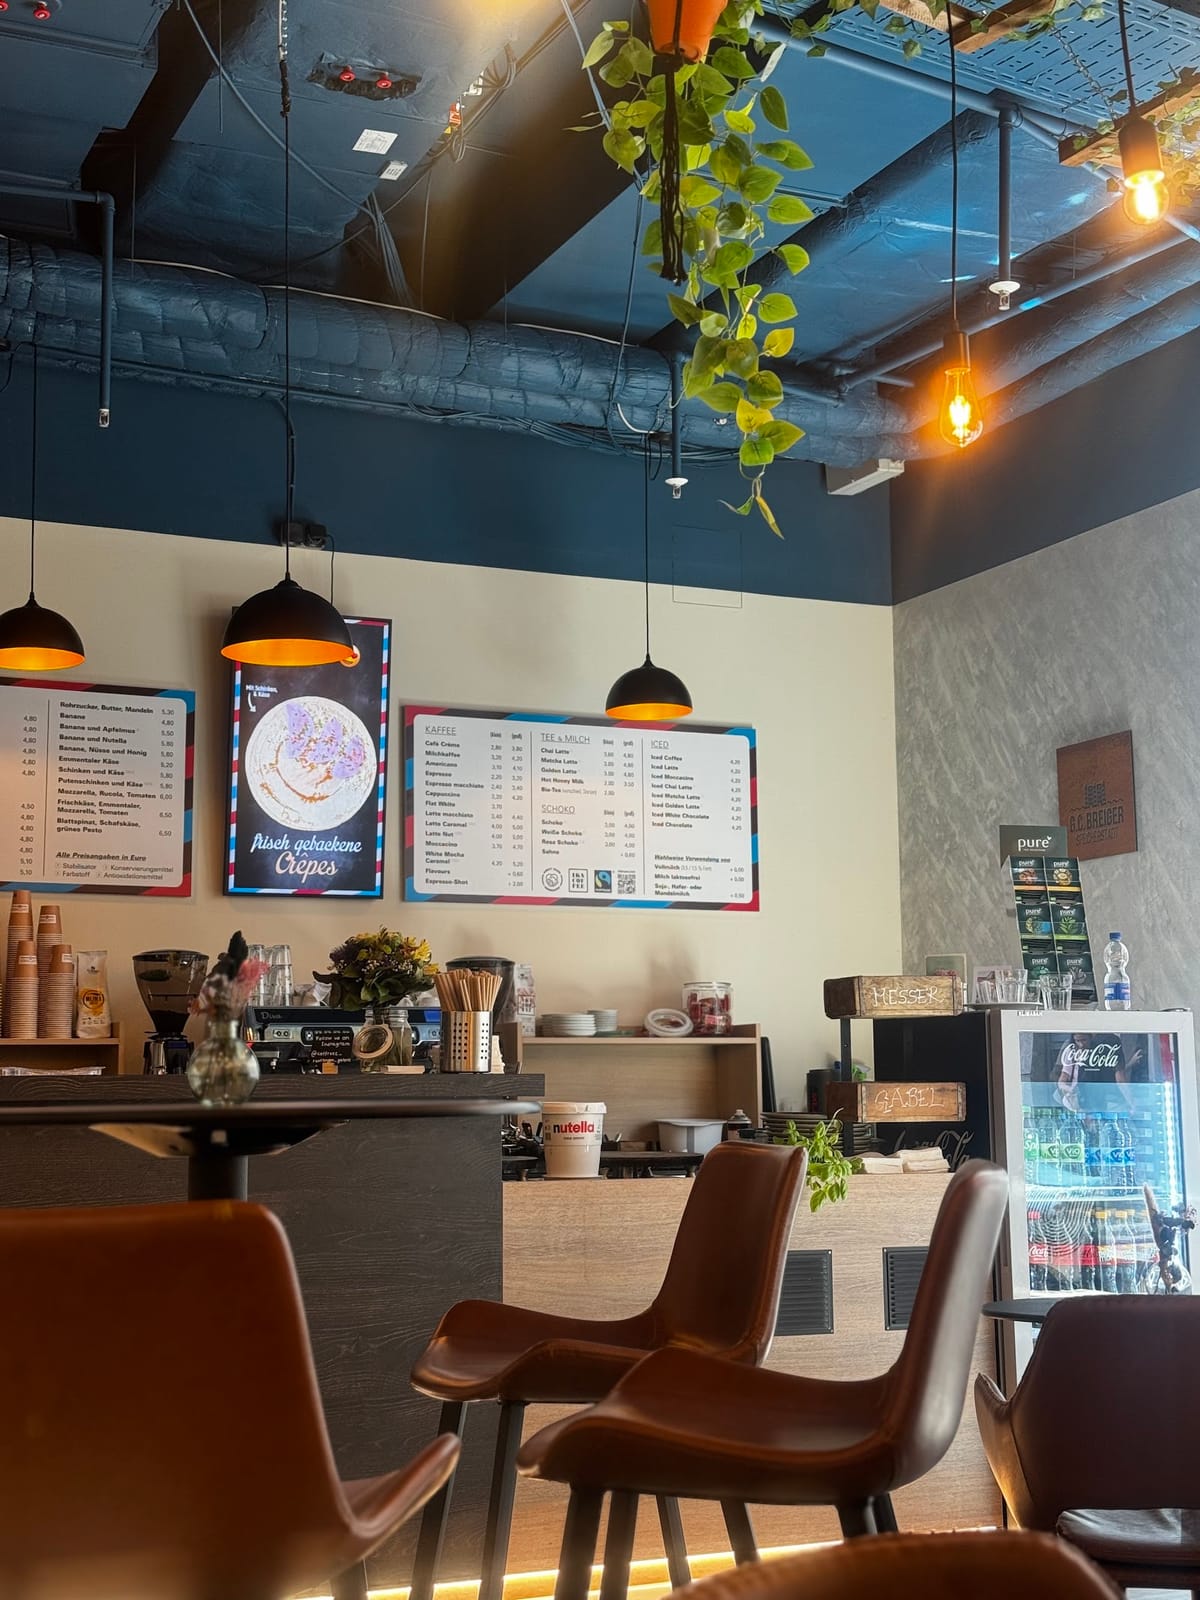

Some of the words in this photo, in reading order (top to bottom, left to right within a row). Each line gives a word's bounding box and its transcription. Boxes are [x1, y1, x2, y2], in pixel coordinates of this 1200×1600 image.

[60, 702, 99, 711] Rohrzucker,
[101, 704, 123, 713] Butter,
[125, 706, 153, 714] Mandeln
[60, 723, 85, 731] Banane
[102, 726, 135, 735] Apfelmus
[425, 726, 457, 735] KAFFEE
[59, 734, 85, 742] Banane
[541, 733, 556, 742] TEE
[564, 735, 590, 744] MILCH
[651, 740, 669, 748] ICED
[59, 745, 87, 753] Banane,
[89, 745, 110, 754] Nüsse
[127, 749, 147, 757] Honig
[58, 756, 100, 764] Emmentaler
[102, 757, 119, 765] Käse
[58, 766, 91, 774] Schinken
[108, 768, 125, 776] Käse
[58, 777, 109, 786] Putenschinken
[126, 780, 143, 788] Käse
[58, 788, 97, 797] Mozzarella,
[99, 790, 125, 798] Rucola,
[58, 799, 97, 807] Frischkäse,
[99, 801, 142, 810] Emmentaler,
[542, 805, 575, 814] SCHOKO
[57, 807, 97, 815] Mozzarella,
[57, 817, 97, 826] Blattspinat,
[99, 819, 141, 828] Schafskäse,
[1087, 806, 1124, 830] BREIGER
[57, 826, 81, 834] grünes
[250, 832, 290, 853] frisch
[294, 834, 363, 857] gebackene
[1018, 838, 1050, 852] pure
[56, 852, 71, 860] Alle
[73, 852, 120, 862] Preisangaben
[275, 851, 338, 883] Crêpes
[1025, 908, 1042, 916] pure
[872, 986, 944, 1007] MESSER
[1061, 1043, 1120, 1067] Coca-Cola
[875, 1088, 945, 1113] GABEL
[553, 1121, 594, 1133] nutella
